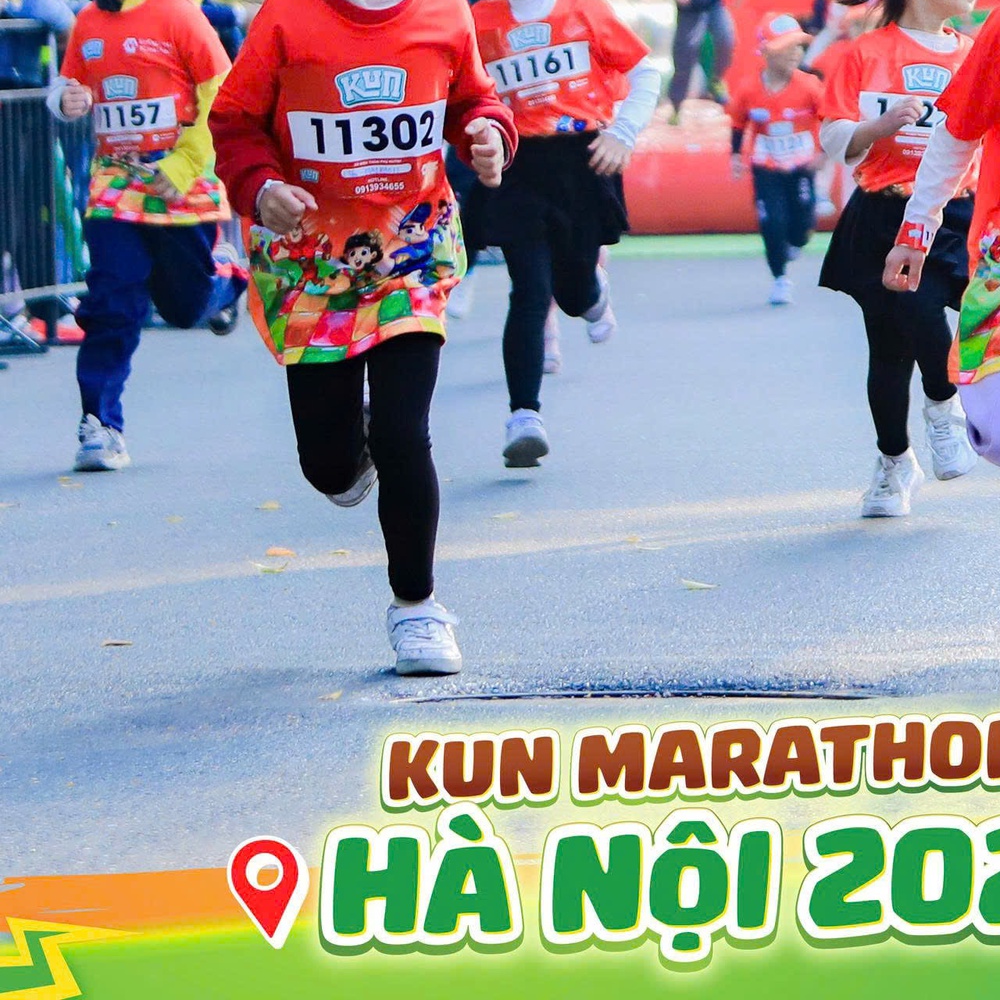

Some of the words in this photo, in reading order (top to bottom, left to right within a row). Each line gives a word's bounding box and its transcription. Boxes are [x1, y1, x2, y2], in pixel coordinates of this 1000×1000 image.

[341, 70, 402, 102] KUN
[496, 47, 575, 86] 11161
[310, 110, 434, 155] 11302
